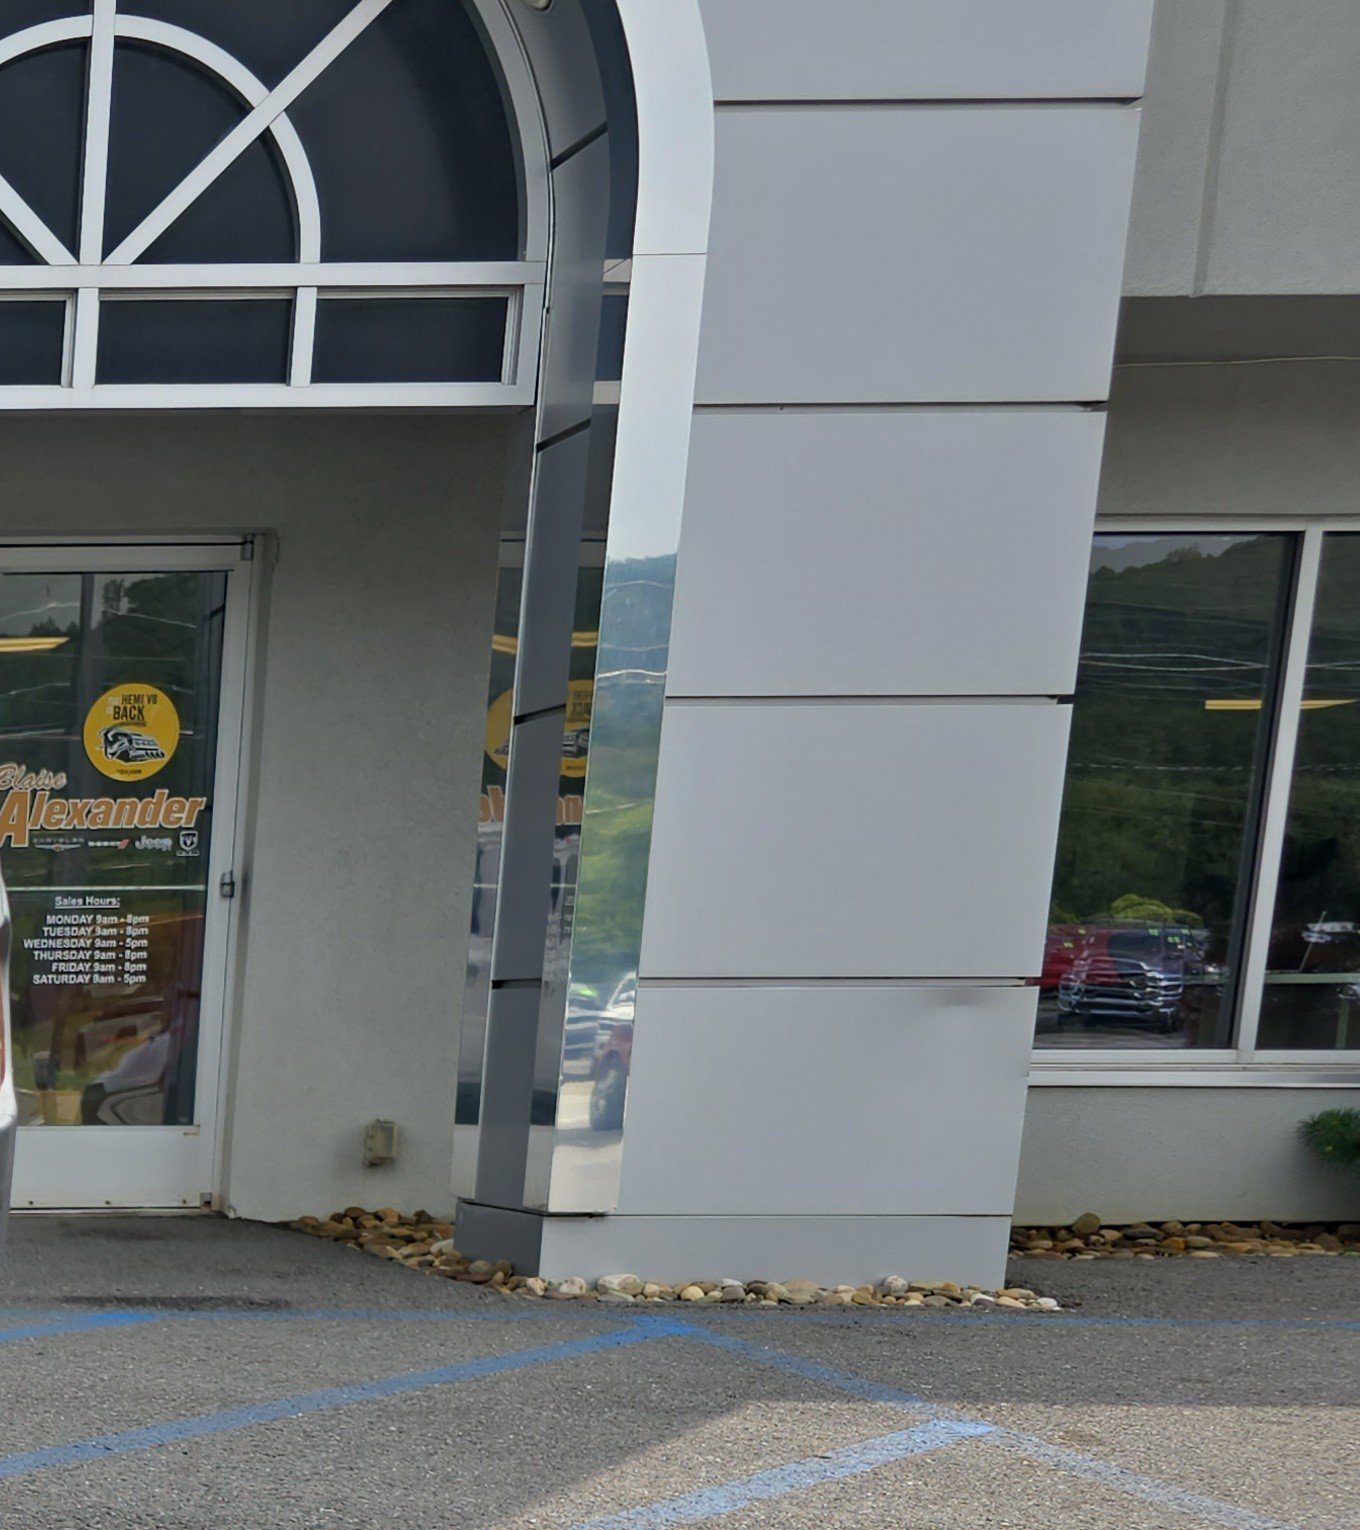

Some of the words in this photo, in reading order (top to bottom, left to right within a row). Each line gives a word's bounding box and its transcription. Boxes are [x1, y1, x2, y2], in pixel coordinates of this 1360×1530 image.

[113, 705, 145, 720] BACK
[135, 835, 173, 851] Jeep
[55, 896, 83, 906] Sales
[86, 896, 120, 906] Hours:
[46, 914, 93, 924] MONDAY
[42, 926, 94, 937] TUESDAY
[23, 938, 93, 948] WEDNESDAY
[33, 950, 92, 960] THURSDAY
[51, 962, 92, 972] FRIDAY
[33, 974, 92, 984] SATURDAY
